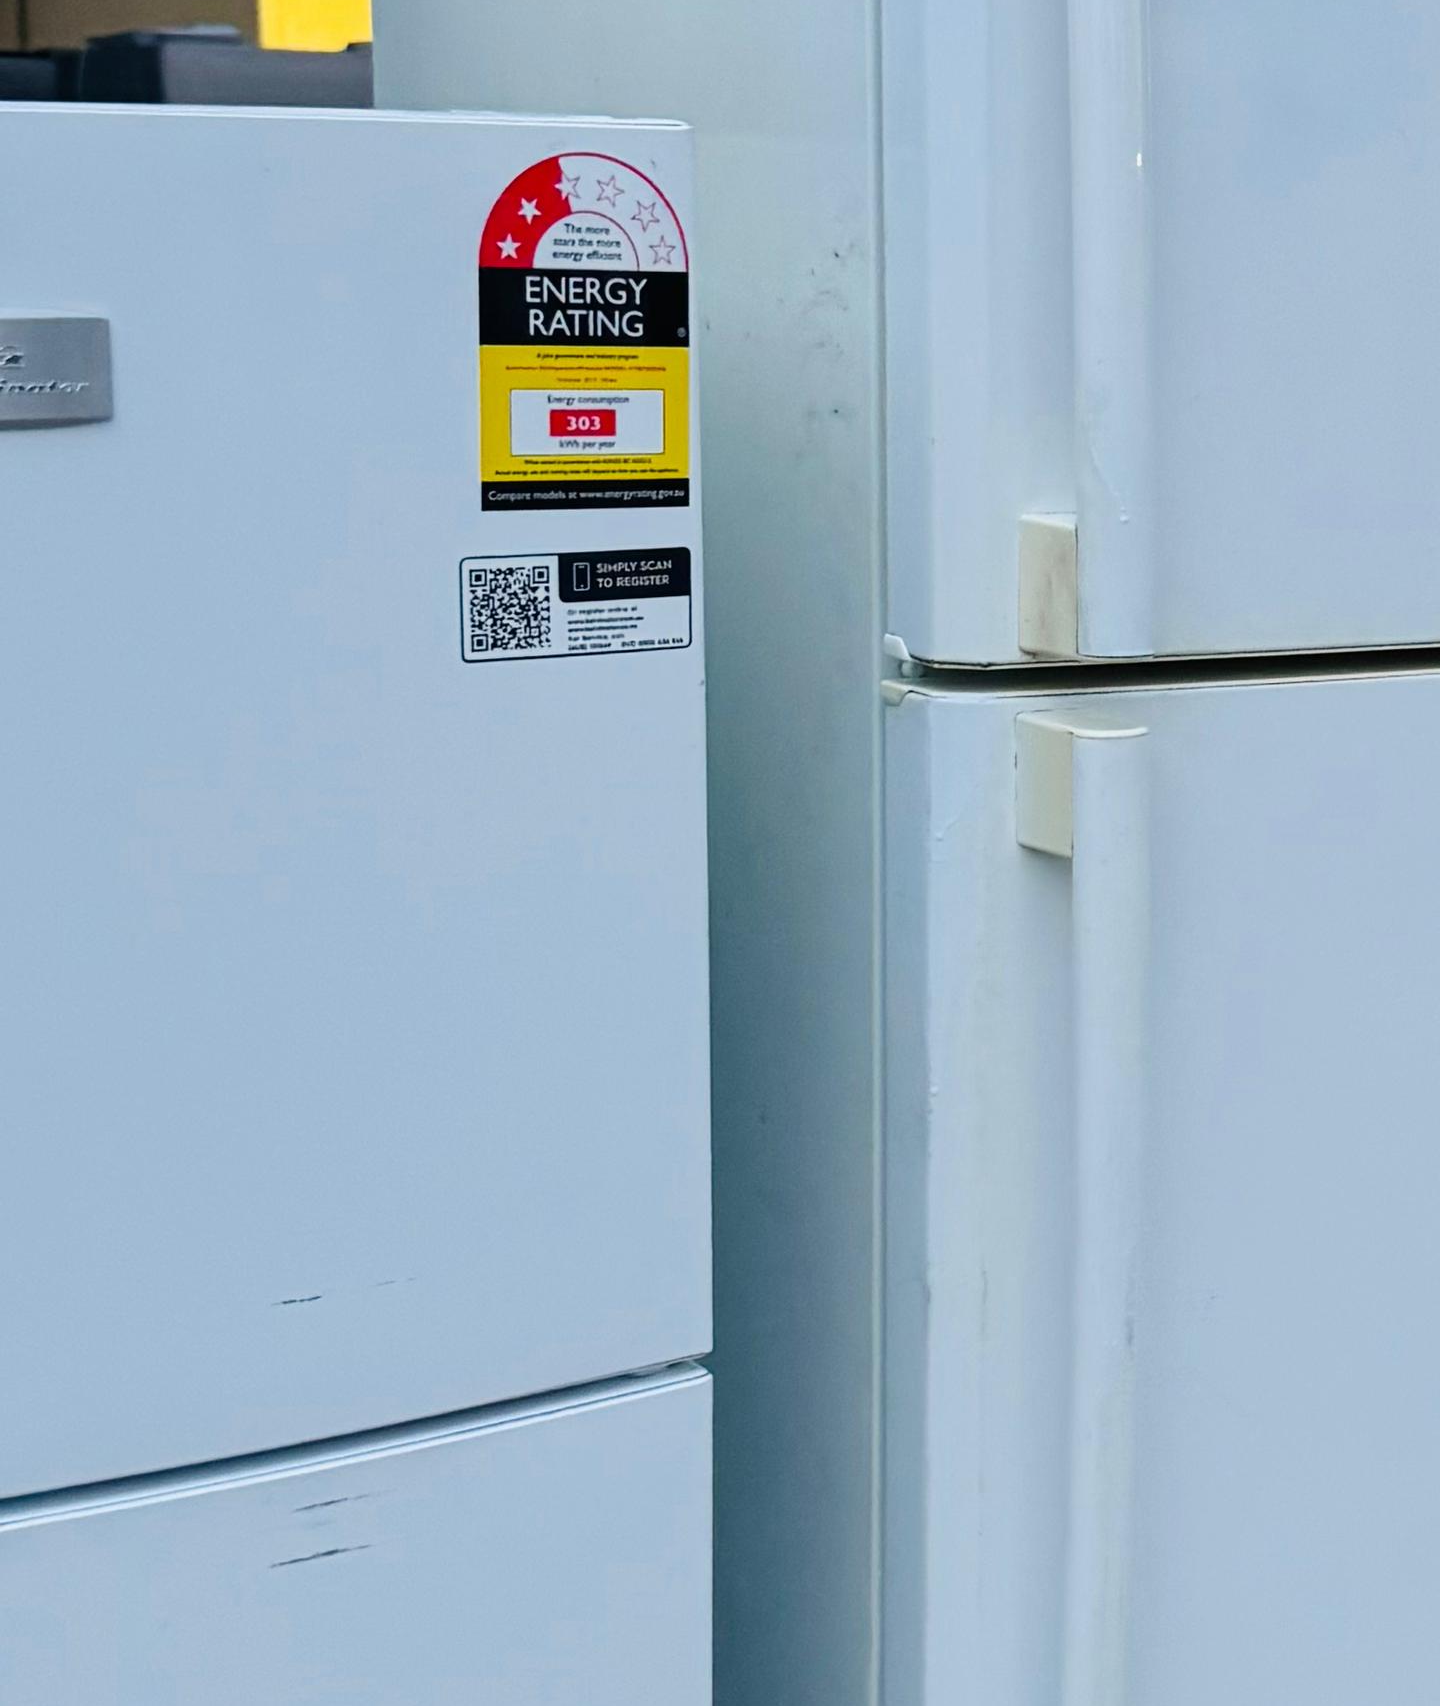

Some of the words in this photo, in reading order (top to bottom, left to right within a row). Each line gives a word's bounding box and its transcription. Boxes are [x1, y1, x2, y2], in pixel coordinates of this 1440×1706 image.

[564, 223, 582, 234] The
[585, 226, 610, 235] more
[578, 238, 593, 247] the
[596, 239, 621, 248] more
[552, 251, 584, 262] energy
[525, 275, 648, 305] ENERGY
[528, 308, 645, 338] RATING
[547, 394, 576, 406] Energy
[577, 396, 630, 406] consumption
[565, 415, 601, 431] 303
[558, 439, 580, 449] kWh
[582, 441, 597, 450] per
[598, 441, 616, 450] year
[487, 490, 531, 502] Compare
[533, 490, 567, 500] models
[568, 491, 578, 500] at
[595, 561, 638, 574] SIMPLY
[639, 559, 673, 571] SCAN
[596, 577, 614, 588] TO
[616, 574, 670, 587] REGISTER
